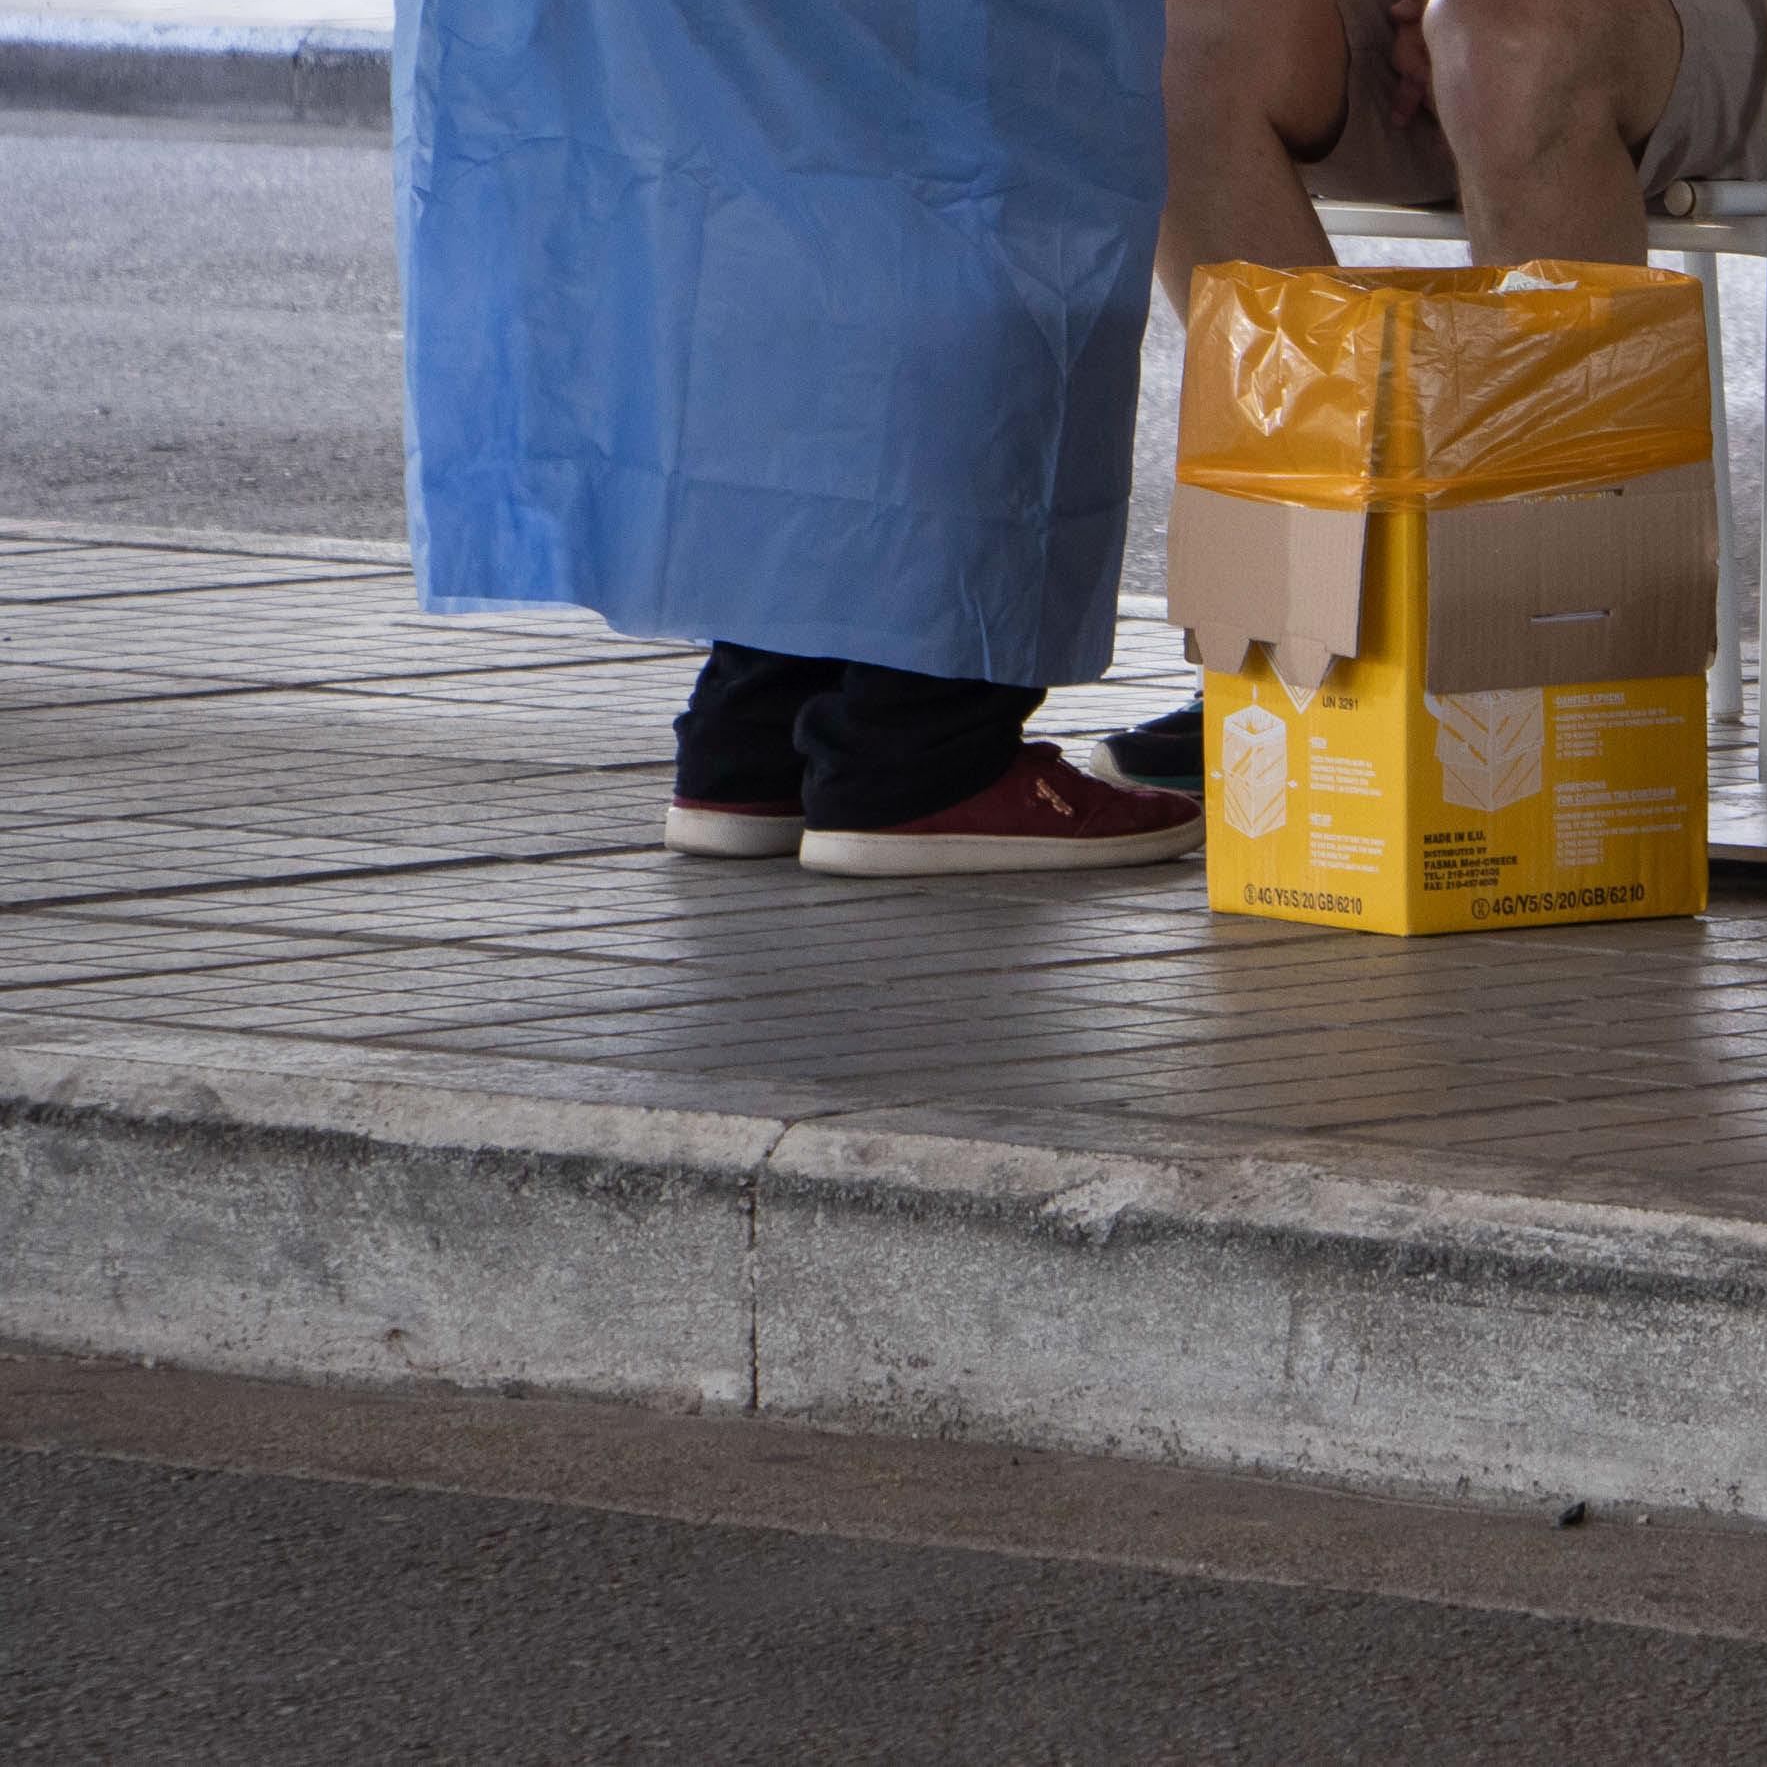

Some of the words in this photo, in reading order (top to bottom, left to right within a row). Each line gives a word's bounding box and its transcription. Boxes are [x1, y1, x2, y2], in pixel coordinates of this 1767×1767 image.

[1322, 696, 1336, 709] UN
[1424, 833, 1451, 845] MADE
[1455, 832, 1465, 842] IN
[1424, 847, 1474, 858] DISTRIBUTED
[1492, 884, 1644, 916] 4G/Y5/S/20/GB/6210
